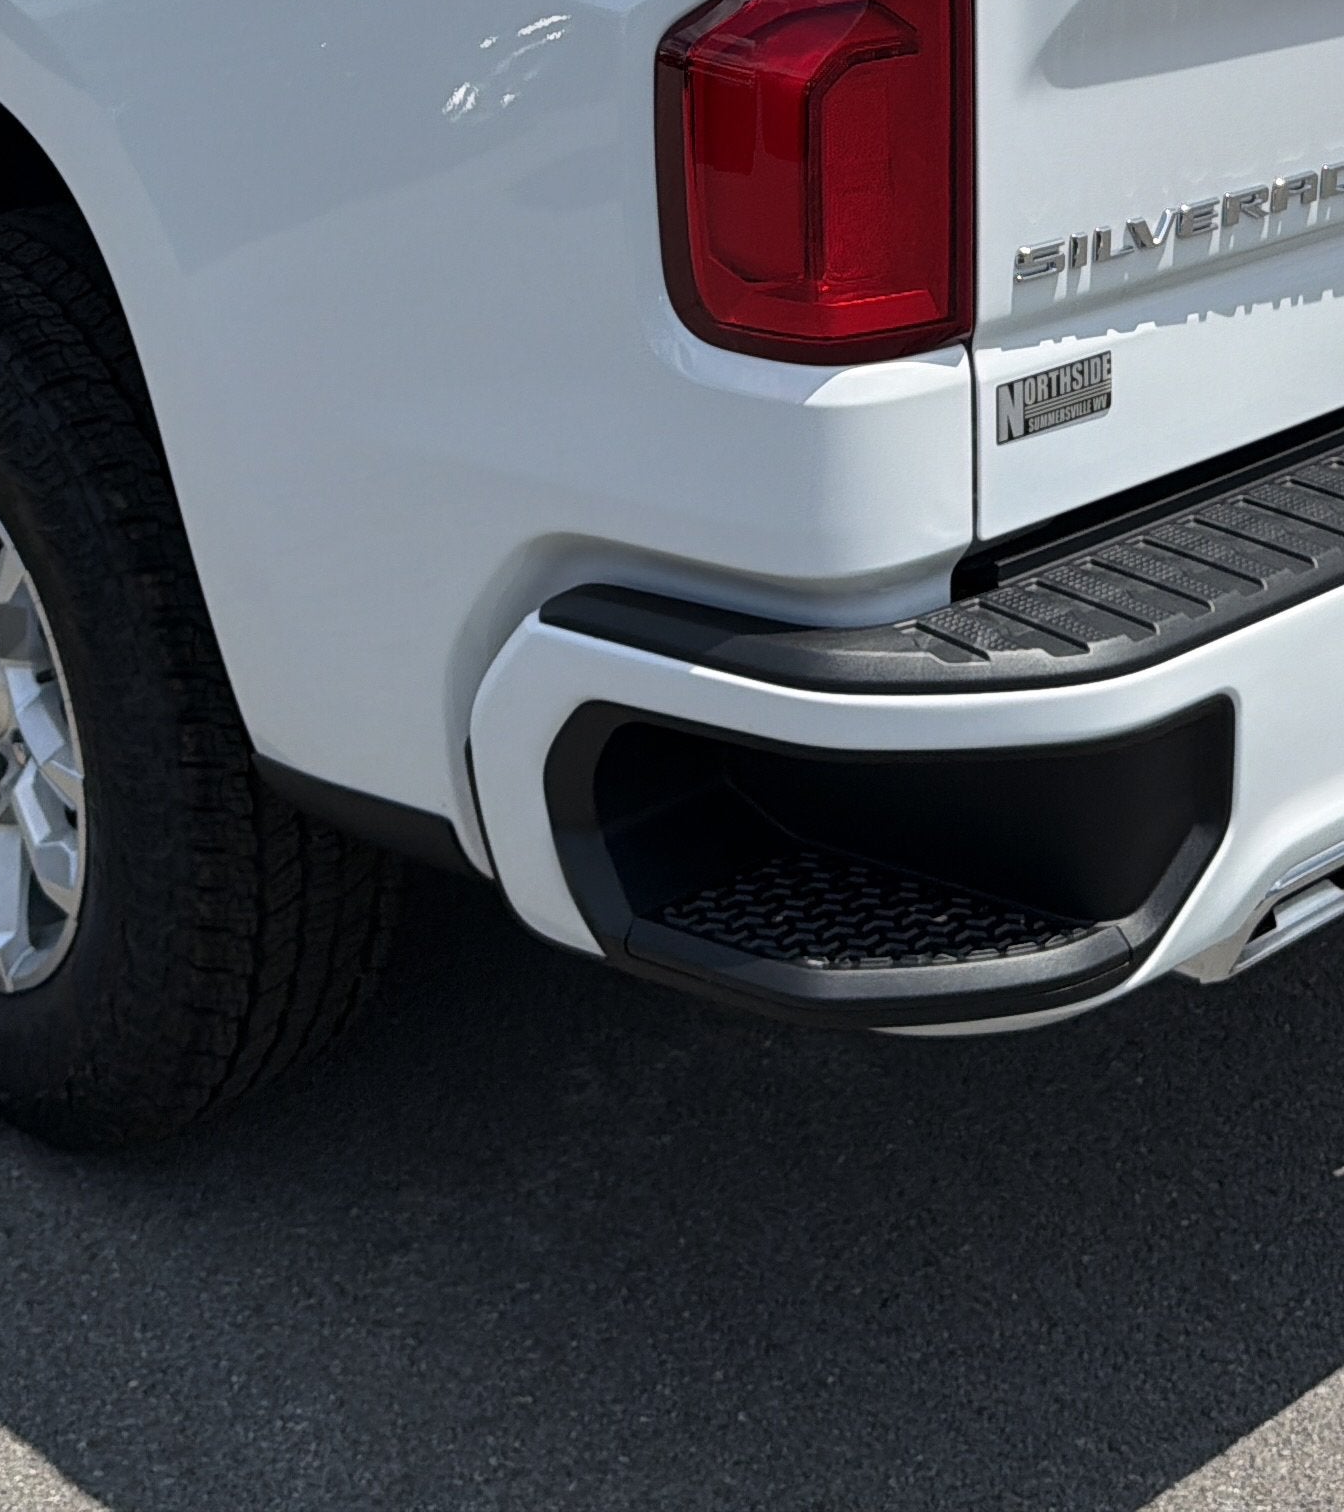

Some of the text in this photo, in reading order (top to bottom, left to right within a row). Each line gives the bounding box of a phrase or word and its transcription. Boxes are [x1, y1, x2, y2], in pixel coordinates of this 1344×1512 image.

[997, 353, 1111, 442] NORTHSIDE
[1028, 393, 1108, 432] SUMMERSVILLE WV
